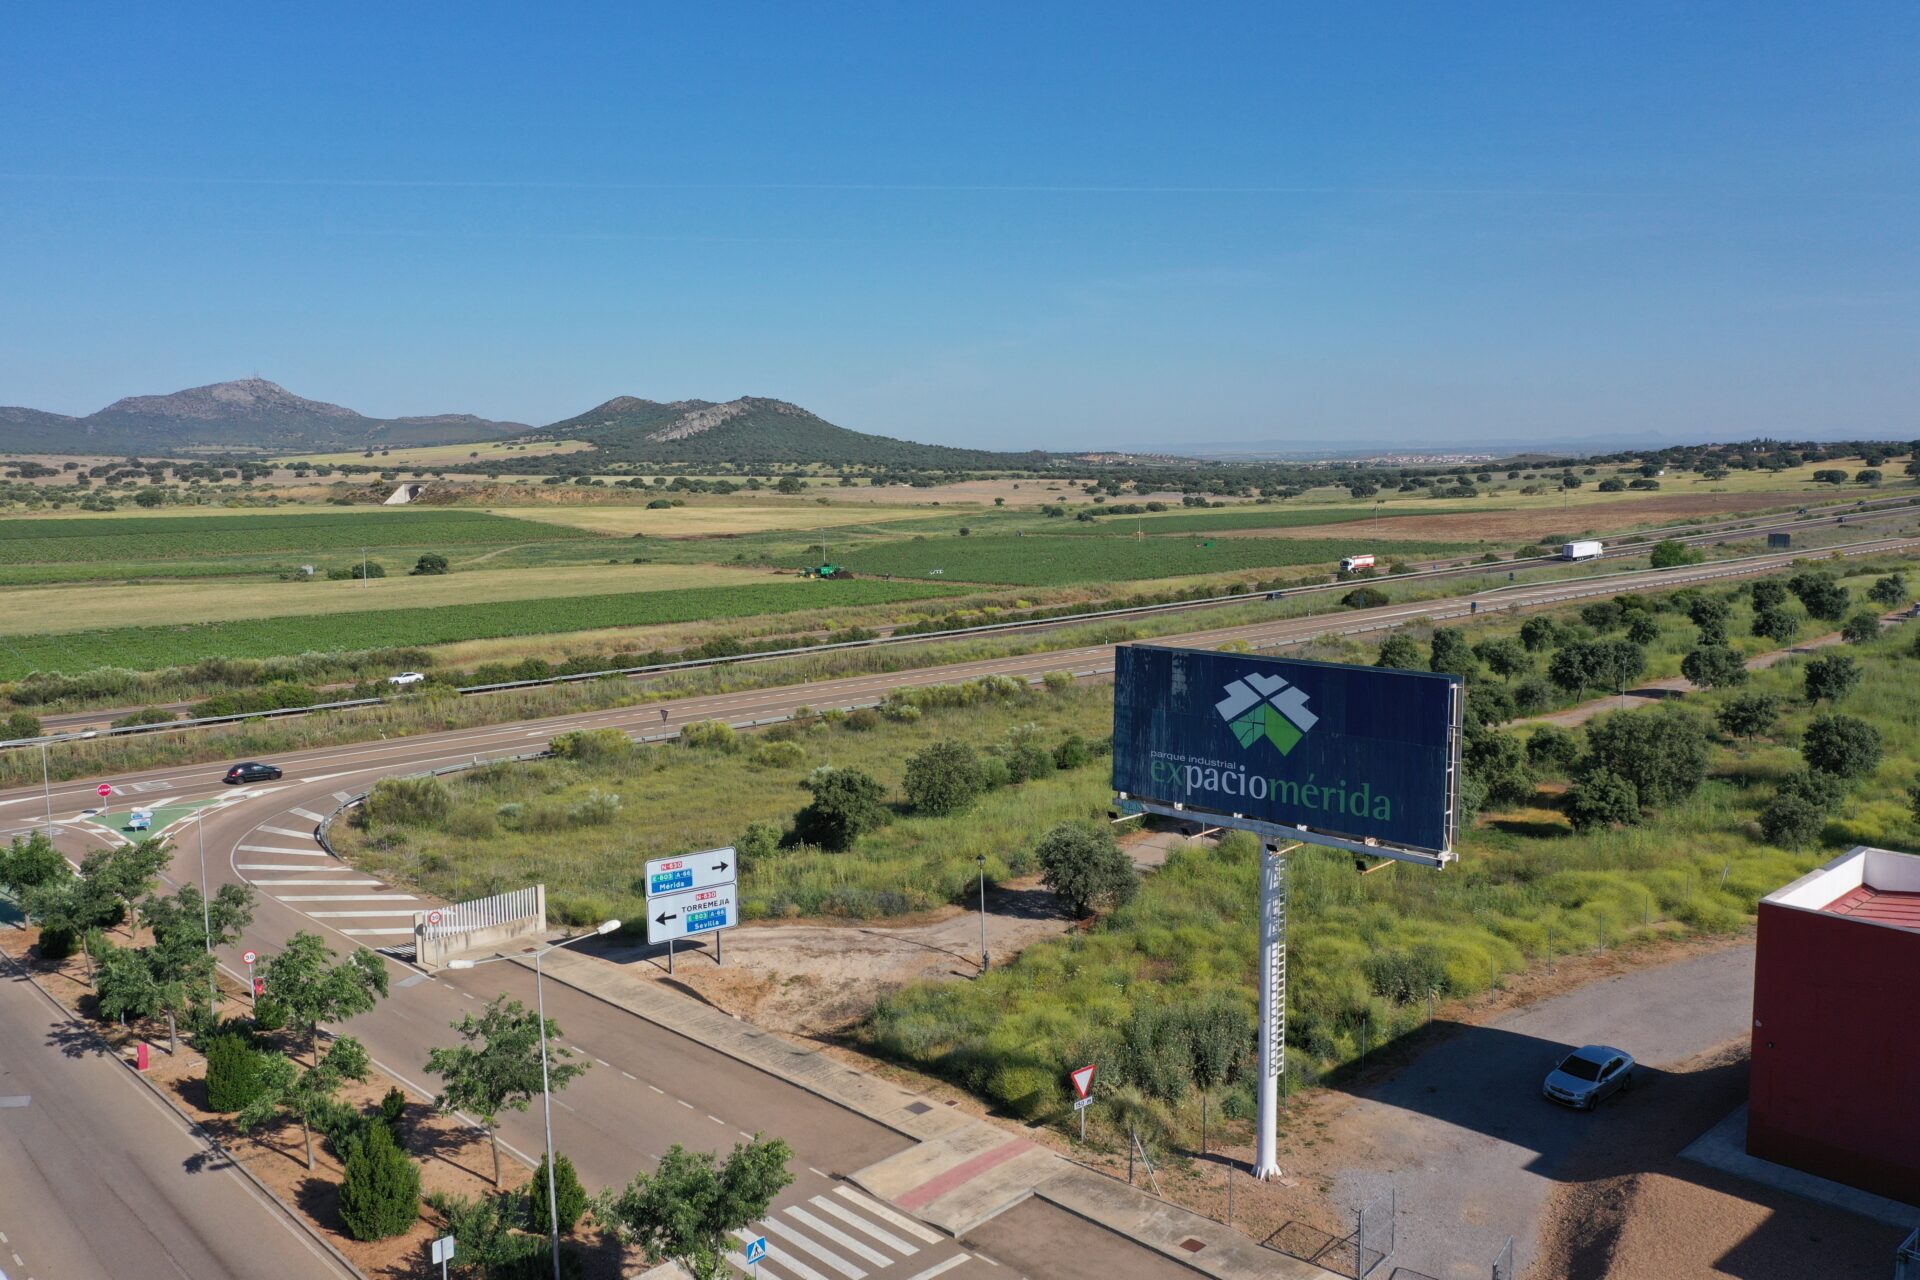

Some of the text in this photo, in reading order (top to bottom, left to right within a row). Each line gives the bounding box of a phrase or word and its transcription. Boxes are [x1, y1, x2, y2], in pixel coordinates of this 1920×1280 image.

[1150, 750, 1236, 770] parque industrial
[1150, 759, 1391, 822] expaciomérida
[661, 861, 682, 870] N-630
[696, 891, 716, 900] N-630
[694, 919, 720, 930] Sevilla
